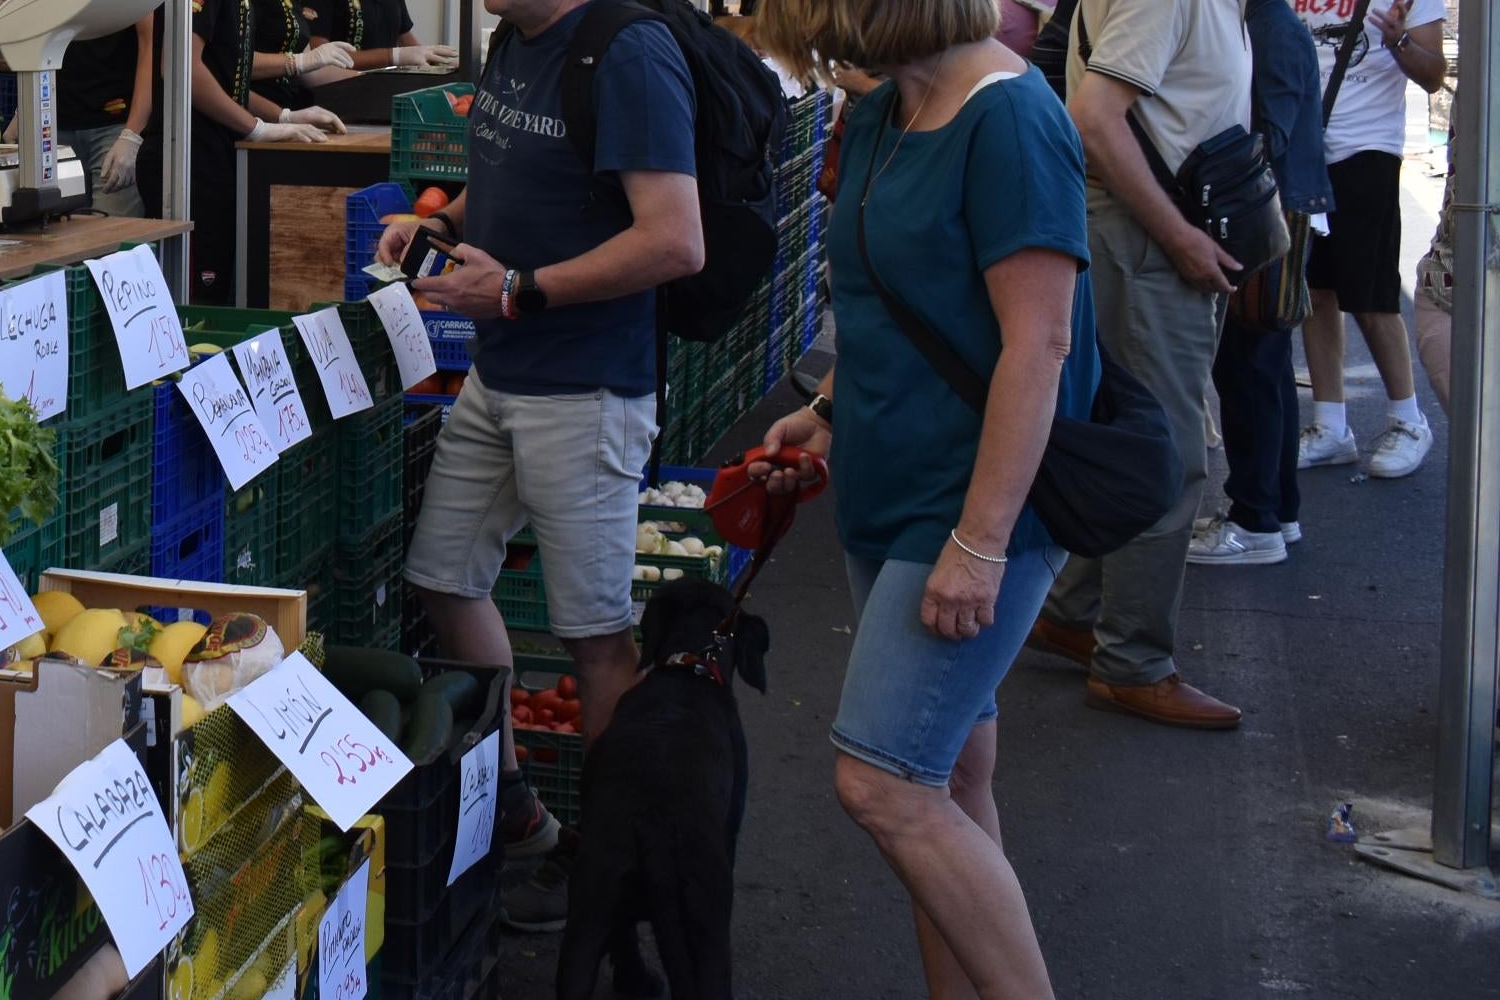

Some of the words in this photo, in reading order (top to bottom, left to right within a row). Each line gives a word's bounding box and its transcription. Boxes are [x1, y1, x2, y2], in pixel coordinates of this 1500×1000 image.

[101, 270, 156, 312] PEPINO
[0, 302, 57, 341] LECHUGA
[301, 326, 337, 364] UVA
[246, 674, 323, 740] LIMÓN
[57, 769, 154, 851] CALABAZA
